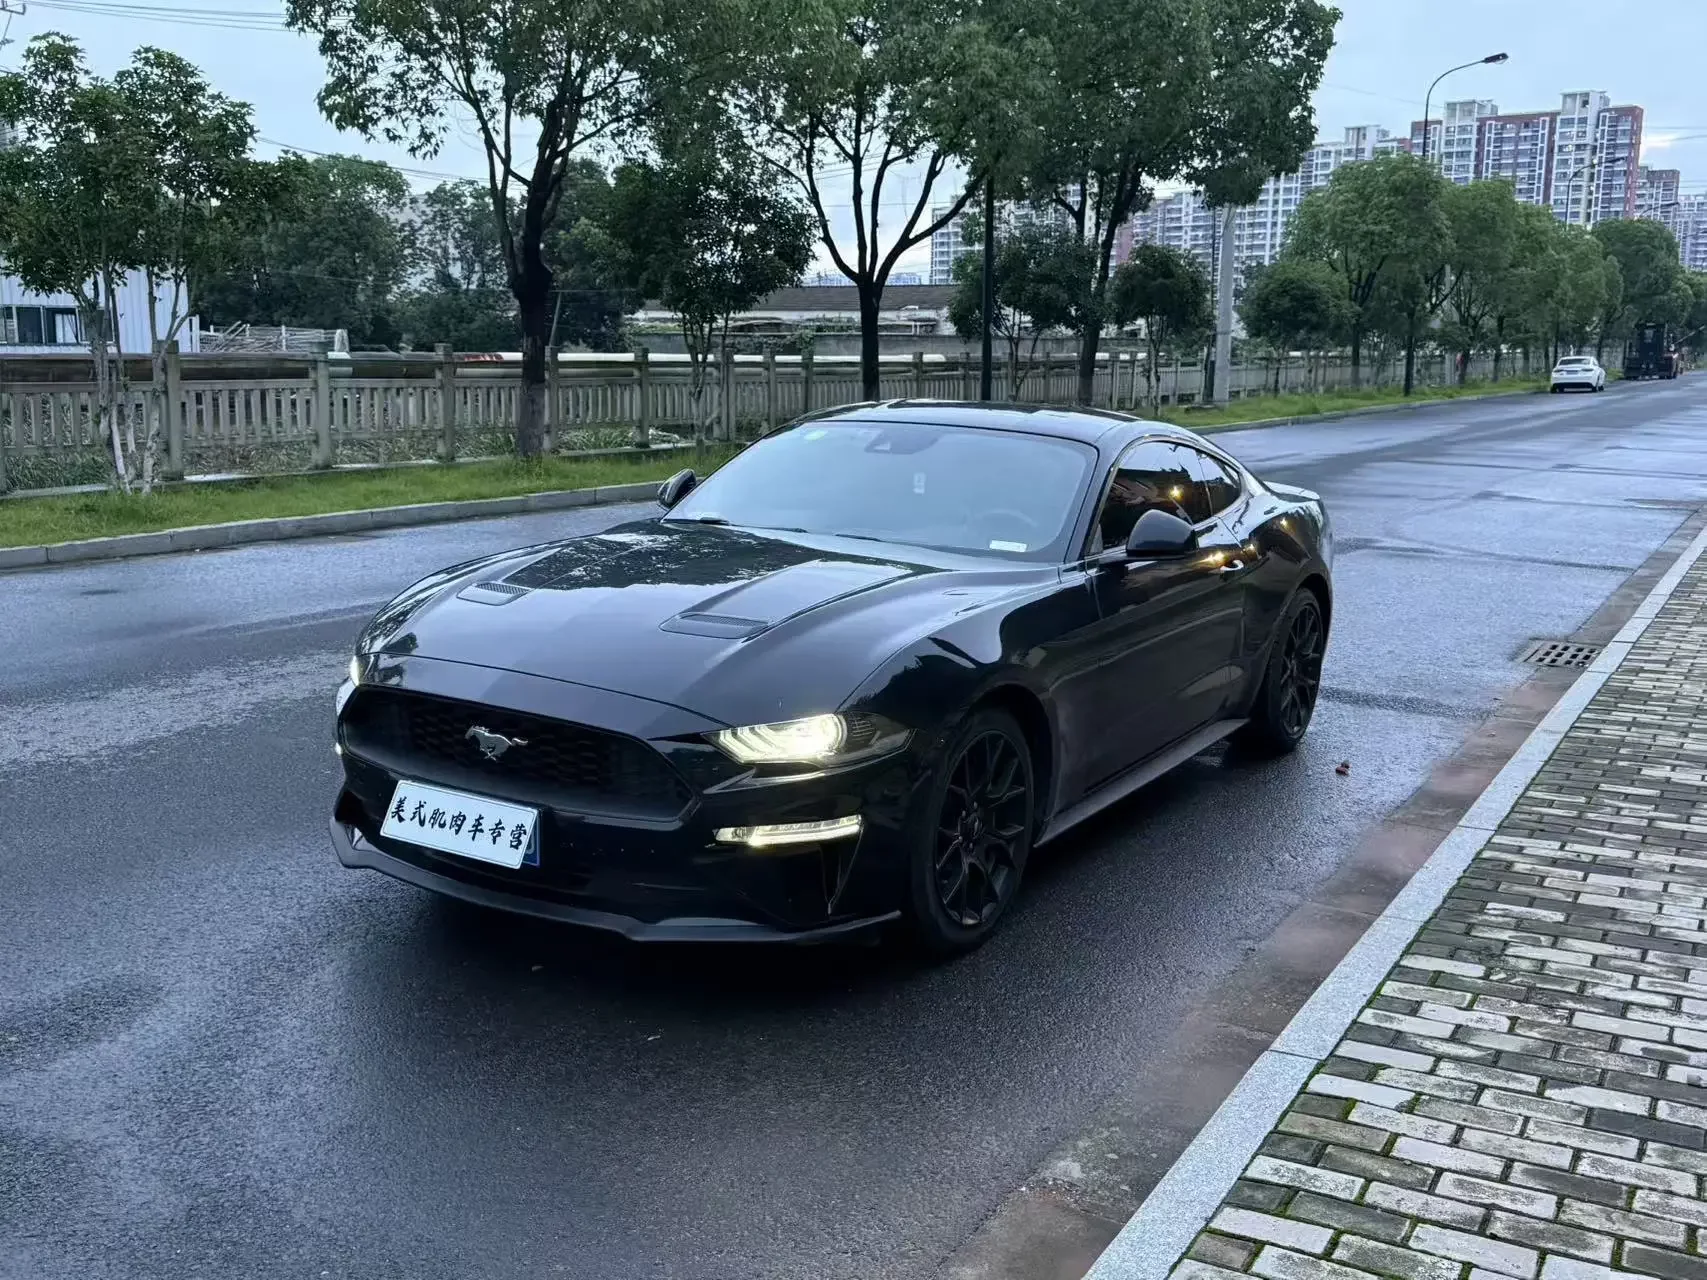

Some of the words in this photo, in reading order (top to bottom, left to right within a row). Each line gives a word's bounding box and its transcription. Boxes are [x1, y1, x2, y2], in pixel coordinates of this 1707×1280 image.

[391, 797, 527, 850] 美式肌肉车专营
